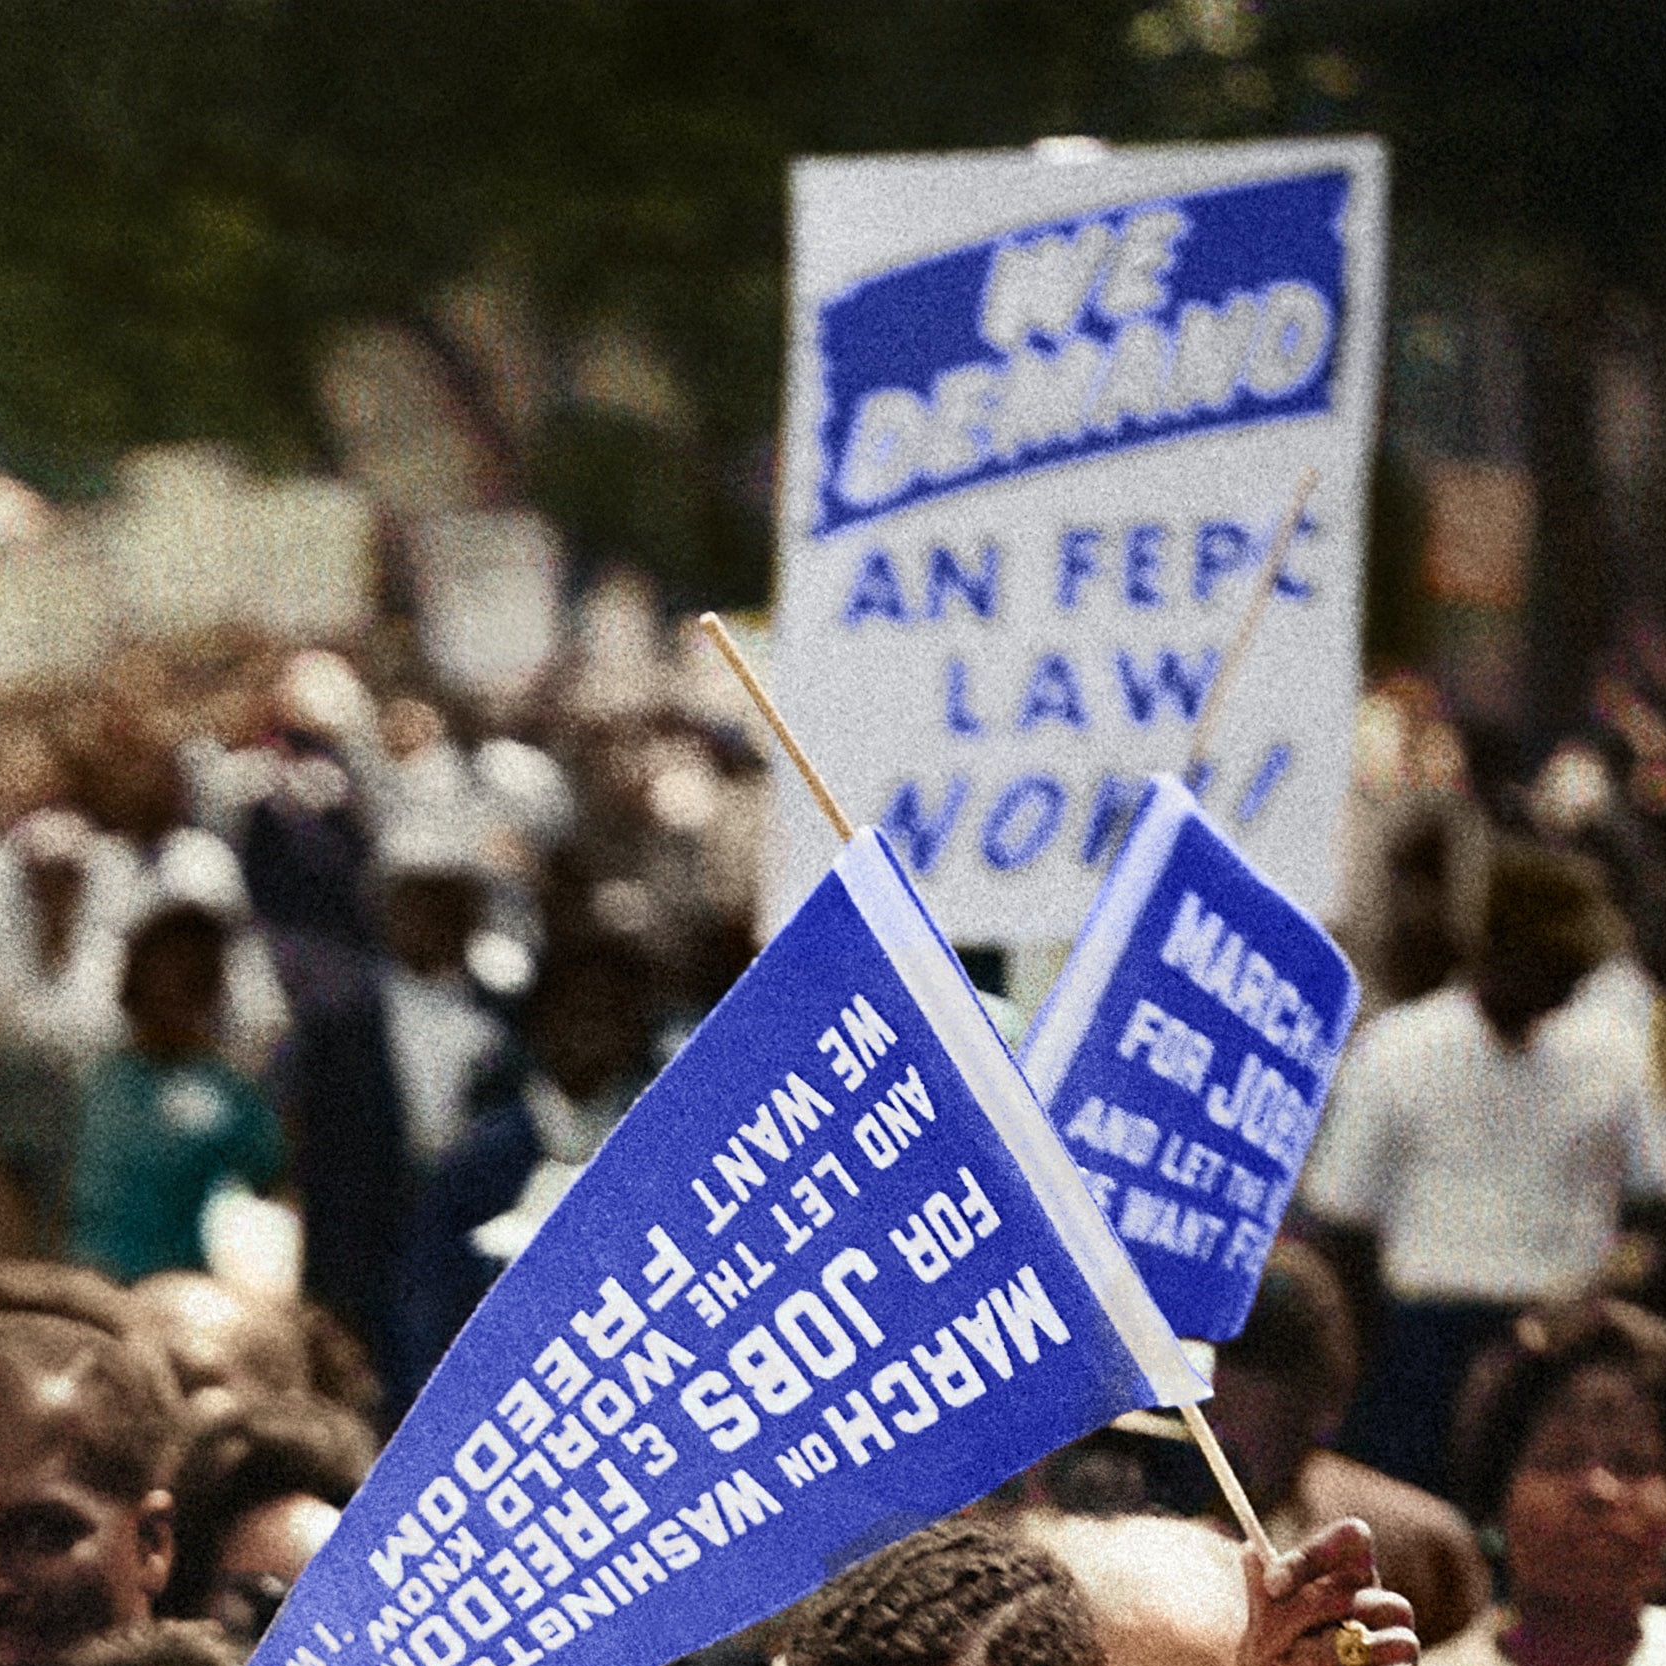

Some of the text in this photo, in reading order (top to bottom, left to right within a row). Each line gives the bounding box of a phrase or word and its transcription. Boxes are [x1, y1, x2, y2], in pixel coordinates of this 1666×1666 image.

[981, 208, 1190, 352] WE
[840, 281, 1330, 506] DEMAND
[842, 544, 1000, 627] AN
[945, 645, 1222, 739] LAW
[1063, 1095, 1161, 1167] AND
[1160, 1130, 1226, 1193] LET
[1118, 998, 1318, 1174] FOR JOB
[889, 1167, 1002, 1283] FOR
[1120, 1185, 1226, 1263] WANT
[368, 993, 898, 1588] WE WANT FREEDOM
[679, 1247, 886, 1452] JOBS
[367, 1064, 936, 1653] AND LET THE WORLD KNOW
[823, 1266, 1071, 1466] MARCH
[620, 1422, 678, 1477] &
[775, 1432, 838, 1489] ON
